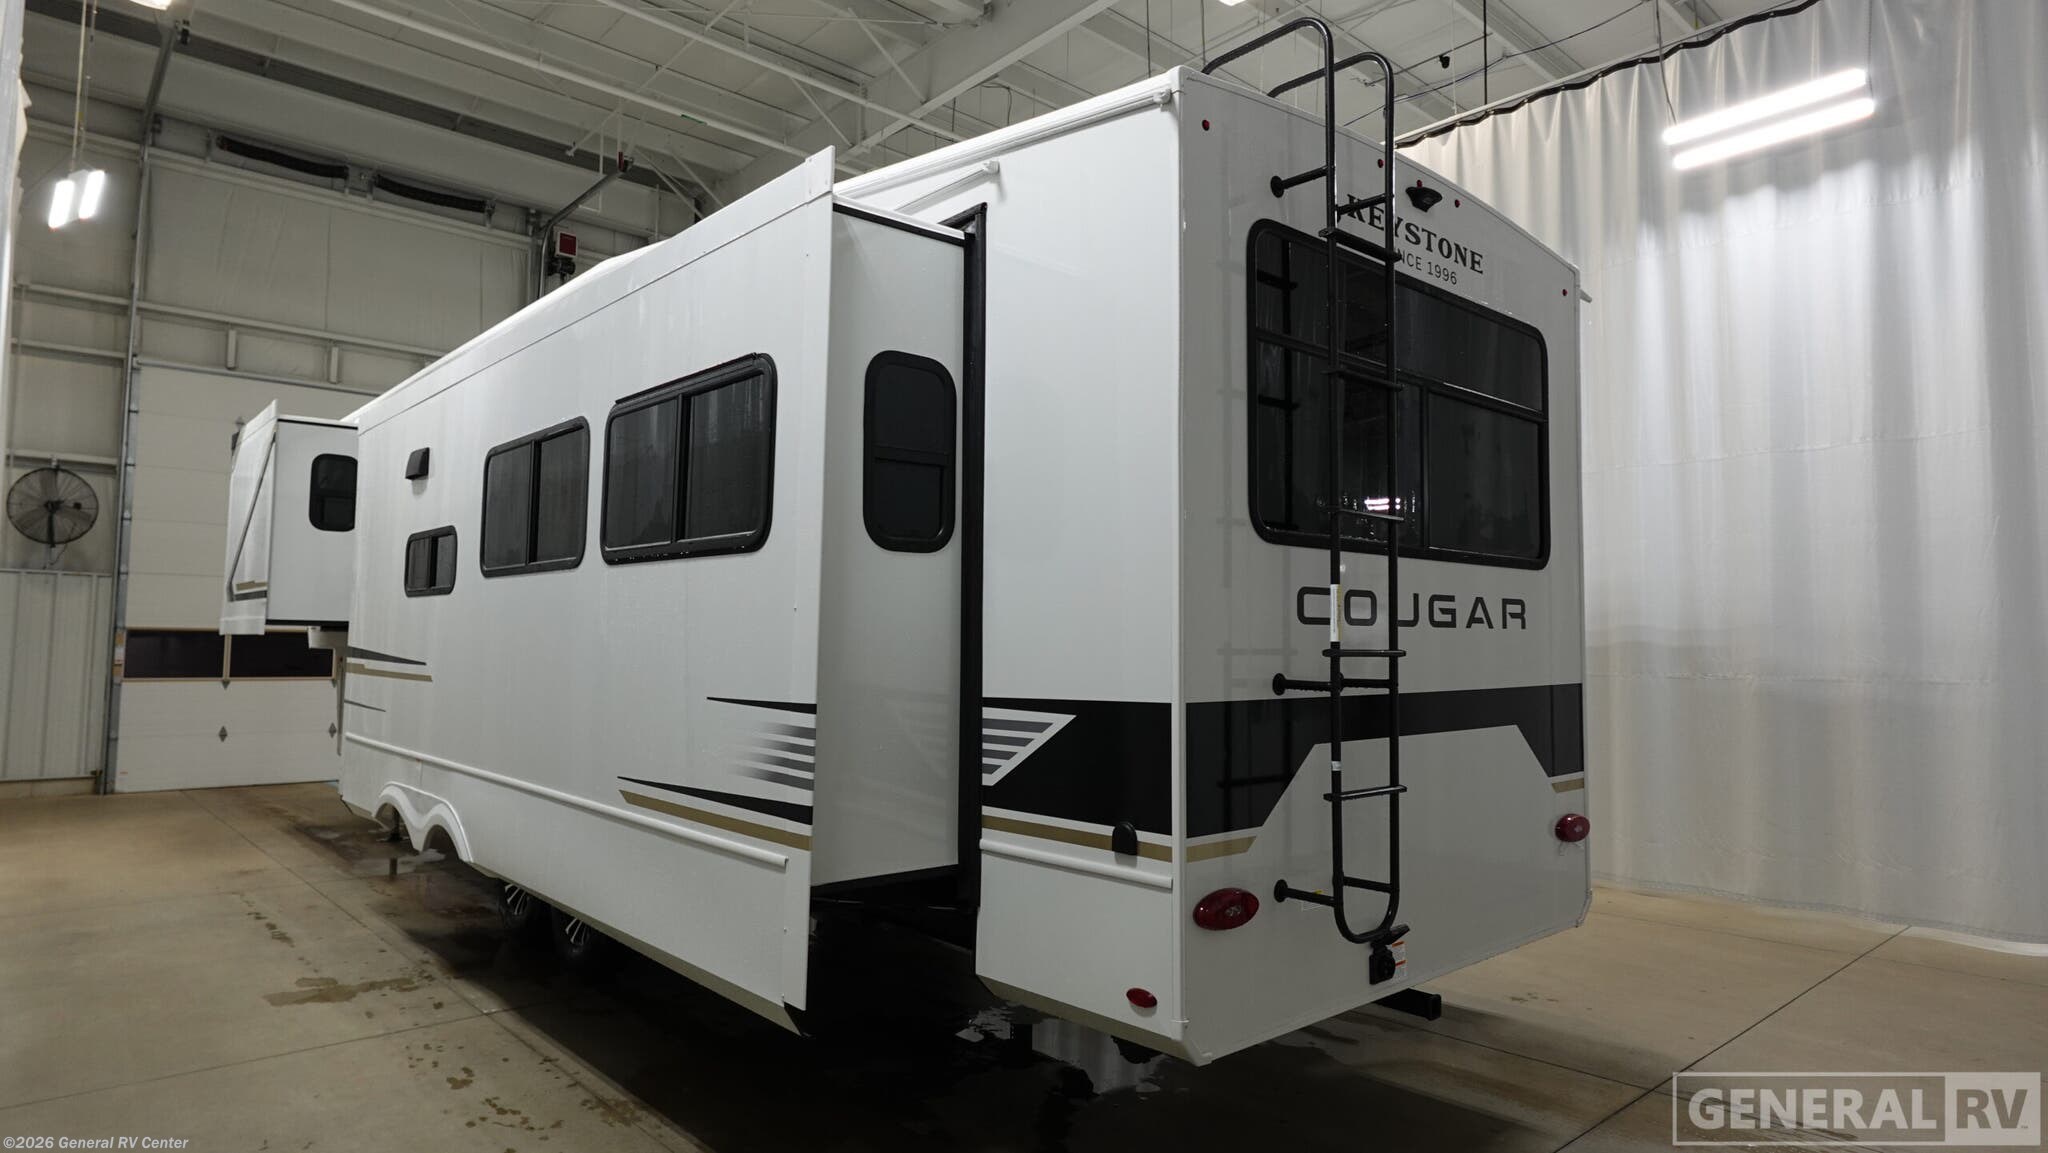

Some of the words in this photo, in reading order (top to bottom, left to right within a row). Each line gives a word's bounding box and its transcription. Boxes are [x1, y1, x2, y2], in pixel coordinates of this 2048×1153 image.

[1347, 193, 1484, 275] KEYSTONE
[1397, 248, 1422, 271] NCE
[1427, 261, 1457, 285] 1996
[1297, 586, 1527, 630] COUGAR
